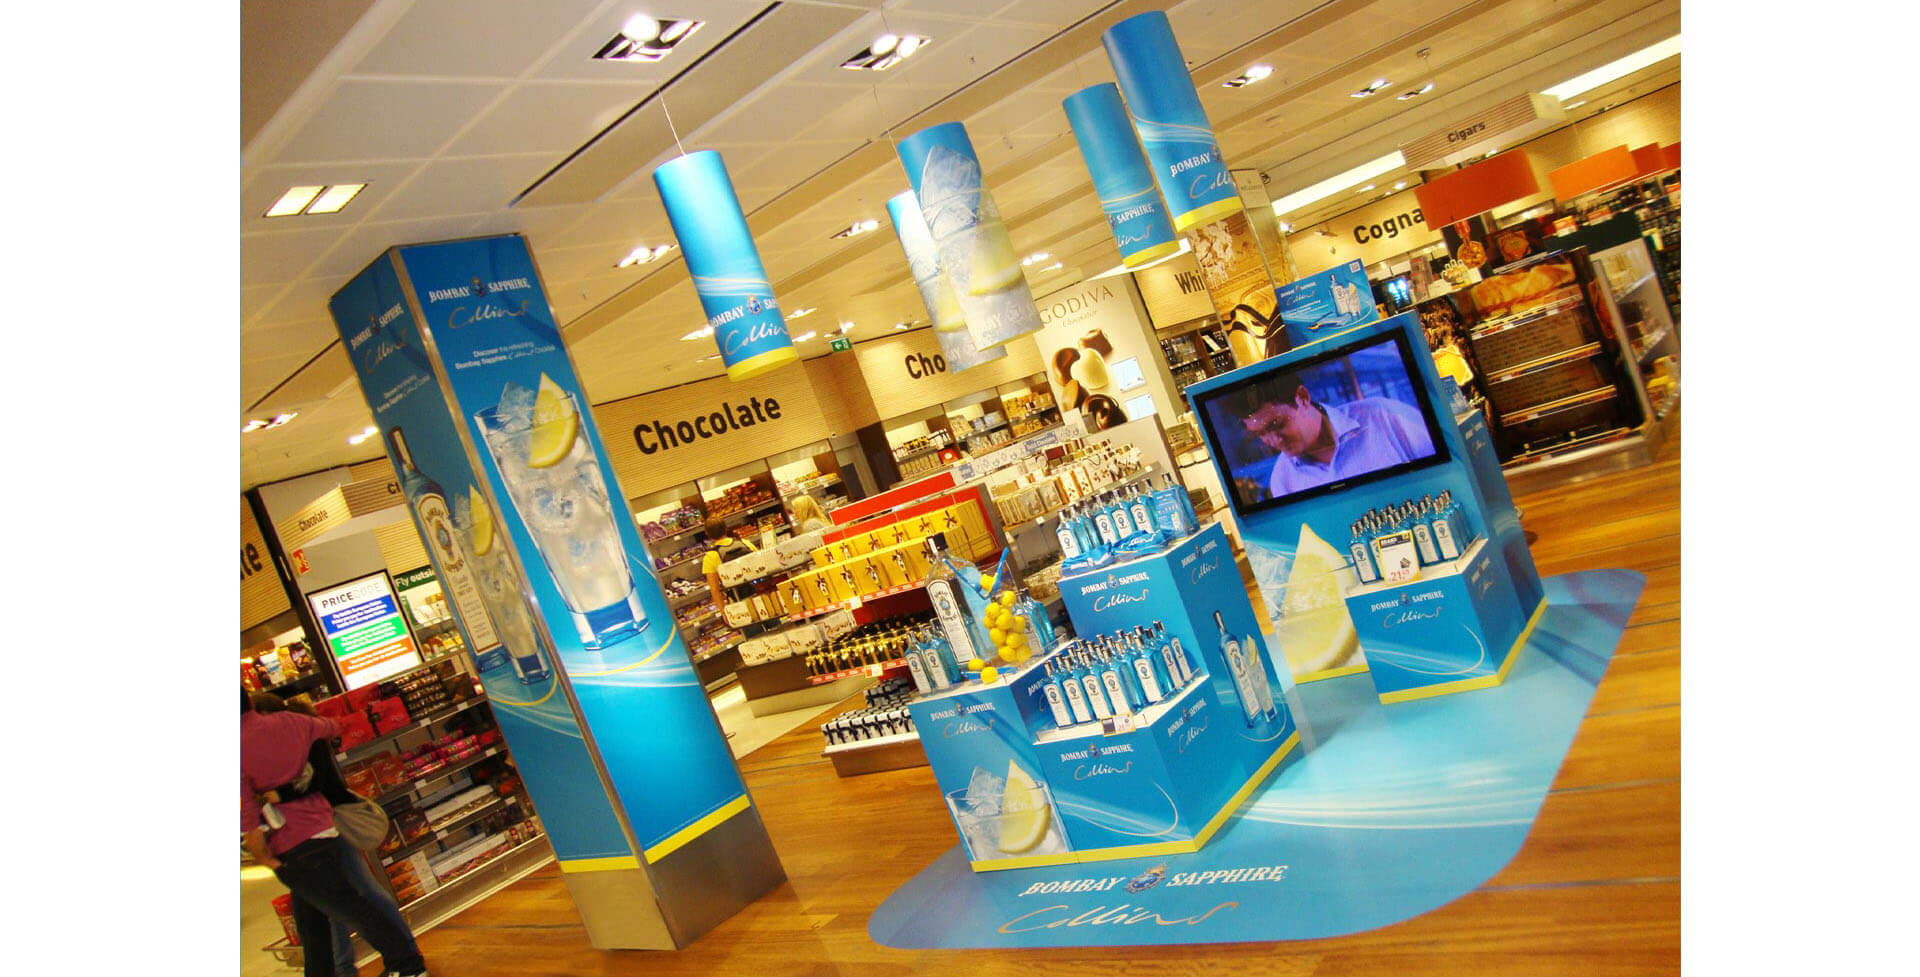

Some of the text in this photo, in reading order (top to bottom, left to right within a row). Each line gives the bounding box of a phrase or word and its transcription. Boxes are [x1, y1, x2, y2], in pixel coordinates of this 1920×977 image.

[1447, 121, 1486, 143] Cigars
[1169, 152, 1211, 178] BOMBAY
[1116, 204, 1155, 224] SAPPHIRE
[1353, 208, 1425, 244] Cogna
[428, 277, 531, 303] BOMBAY SAPPHIRE
[1174, 270, 1205, 295] Whi
[448, 300, 529, 330] Collins
[1039, 285, 1114, 324] GODIVA
[905, 352, 946, 380] Cho
[633, 397, 782, 455] Chocolate
[396, 577, 409, 587] Fly
[1081, 571, 1150, 596] BOMBAY SAPPHIRE
[1093, 588, 1150, 612] Collins
[1371, 590, 1445, 613] BOMBAY SAPPHIRE
[1383, 606, 1443, 628] Collins
[966, 702, 996, 714] SAPPHIRE
[943, 718, 996, 739] Collins
[1060, 743, 1134, 763] BOMBAY SAPPHIRE
[1073, 760, 1133, 781] Collins
[1018, 864, 1289, 897] BOMBAY SAPPHIRE
[998, 901, 1240, 934] Collins
